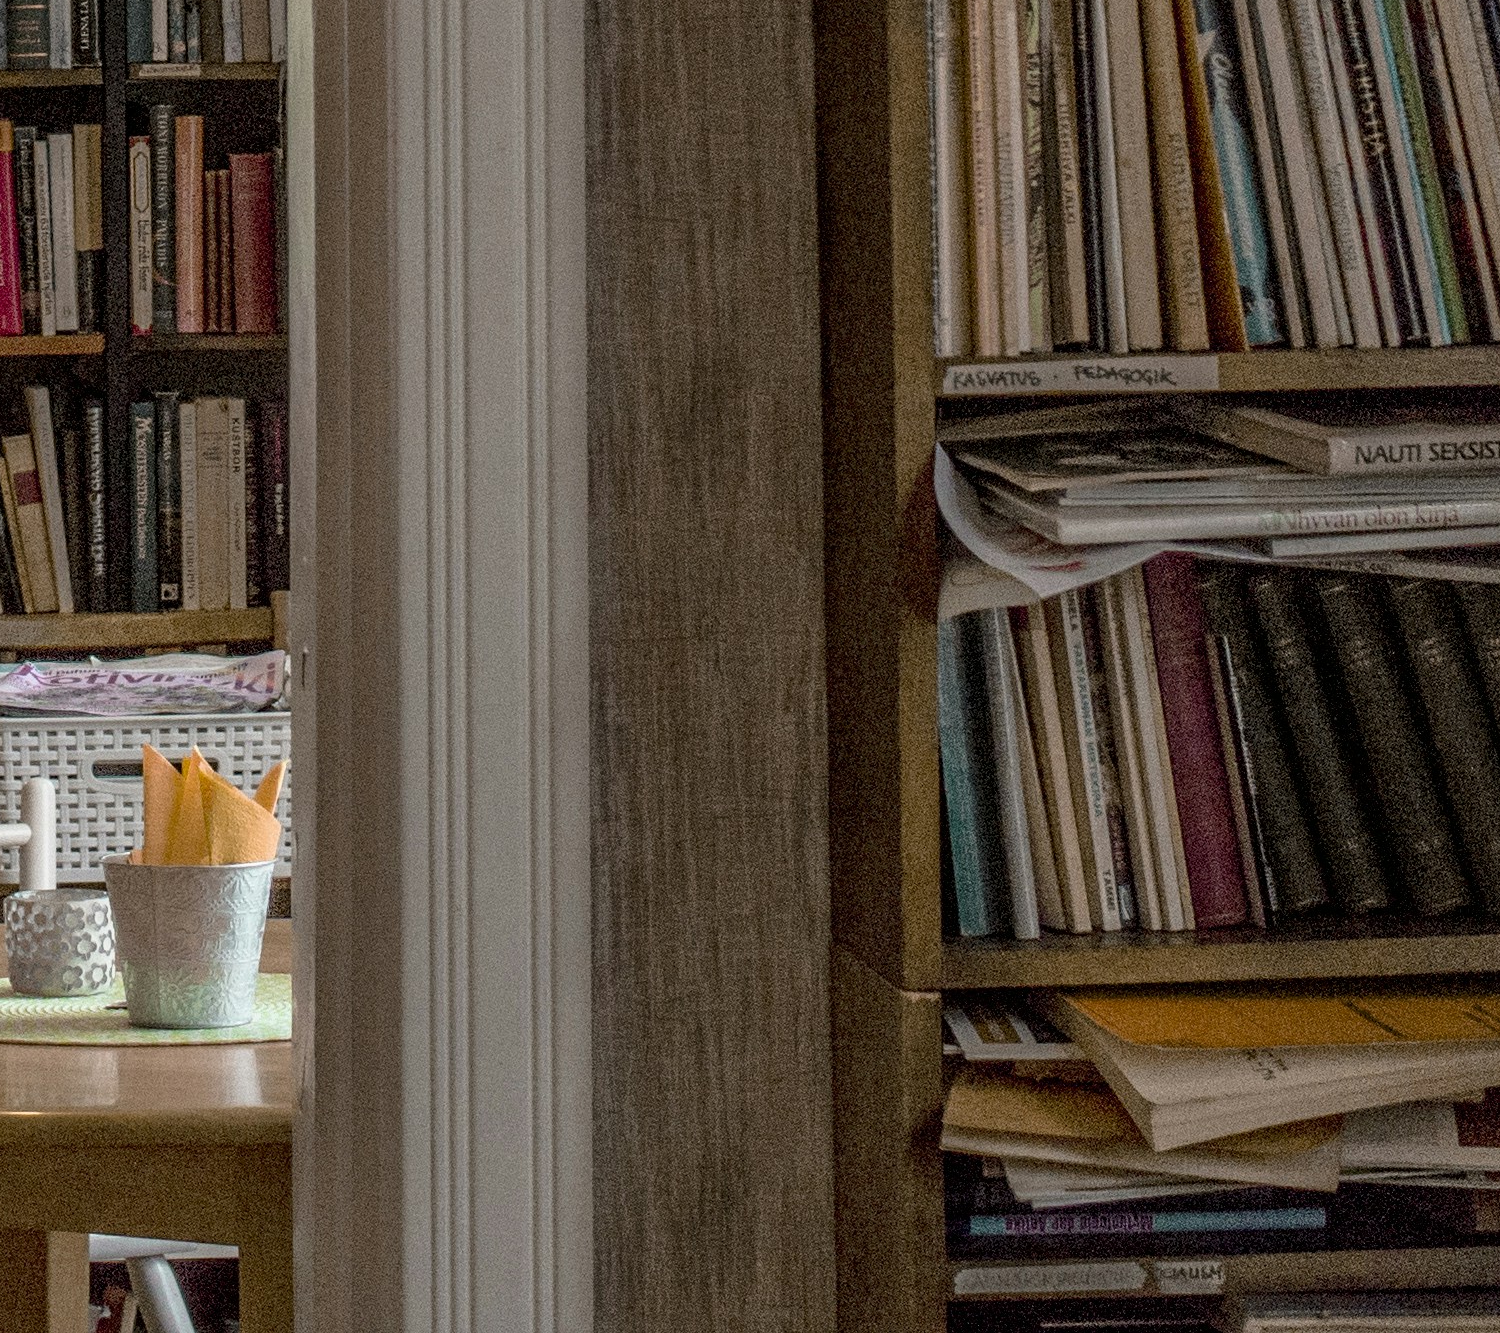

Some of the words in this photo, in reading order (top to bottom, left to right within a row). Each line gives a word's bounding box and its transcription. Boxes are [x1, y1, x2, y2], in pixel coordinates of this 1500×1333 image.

[155, 111, 168, 138] TONI
[1353, 61, 1386, 157] TRISTIA
[156, 142, 169, 210] MORRISON
[156, 219, 169, 267] PARADIS
[952, 370, 1041, 390] KASVATUS
[1073, 365, 1178, 386] PEDAGOGIK
[232, 417, 241, 474] KUSTBOR
[1355, 441, 1422, 465] NAUTI
[1363, 507, 1410, 527] olon
[1413, 502, 1461, 528] kirja
[1103, 869, 1115, 912] TAMMI
